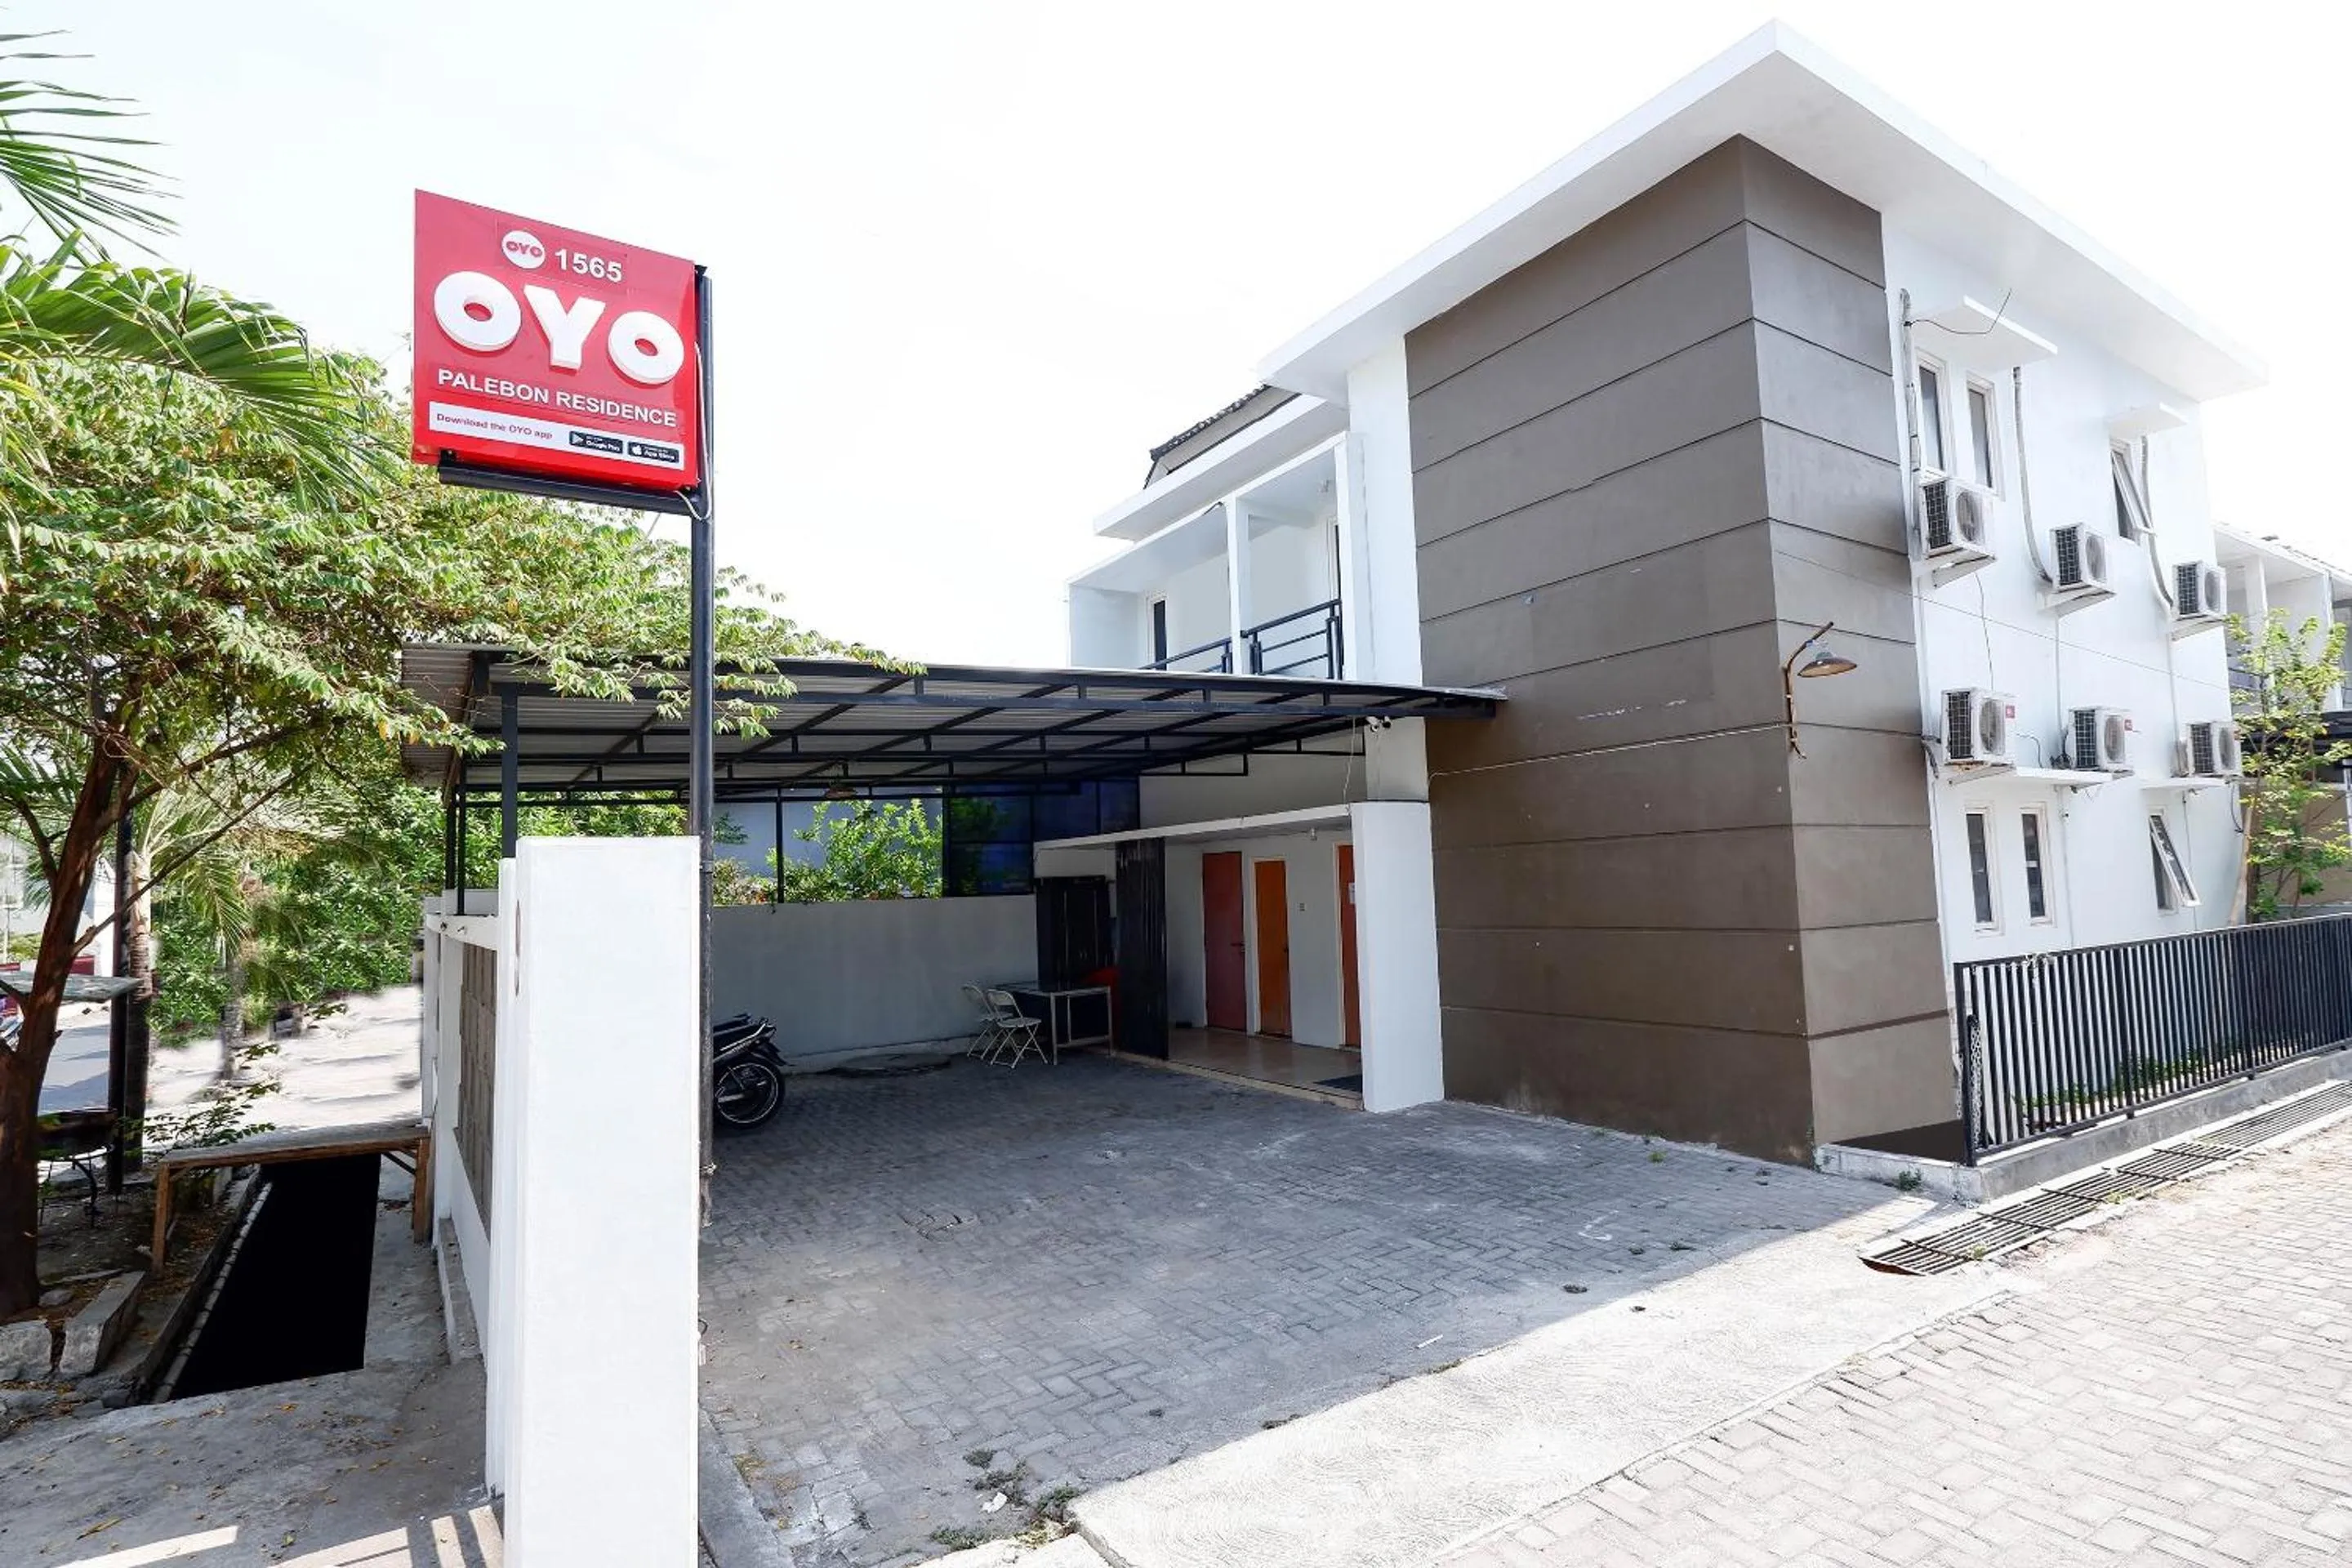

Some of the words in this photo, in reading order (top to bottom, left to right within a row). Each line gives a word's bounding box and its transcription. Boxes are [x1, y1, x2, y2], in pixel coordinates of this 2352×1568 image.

[506, 240, 543, 259] OYO
[555, 248, 622, 283] 1565
[434, 271, 684, 384] OYO
[438, 368, 549, 403] PALEBON
[556, 391, 677, 427] RESIDENCE
[437, 413, 488, 430] Download
[491, 421, 506, 433] the
[509, 424, 532, 436] OYO
[534, 430, 553, 440] app
